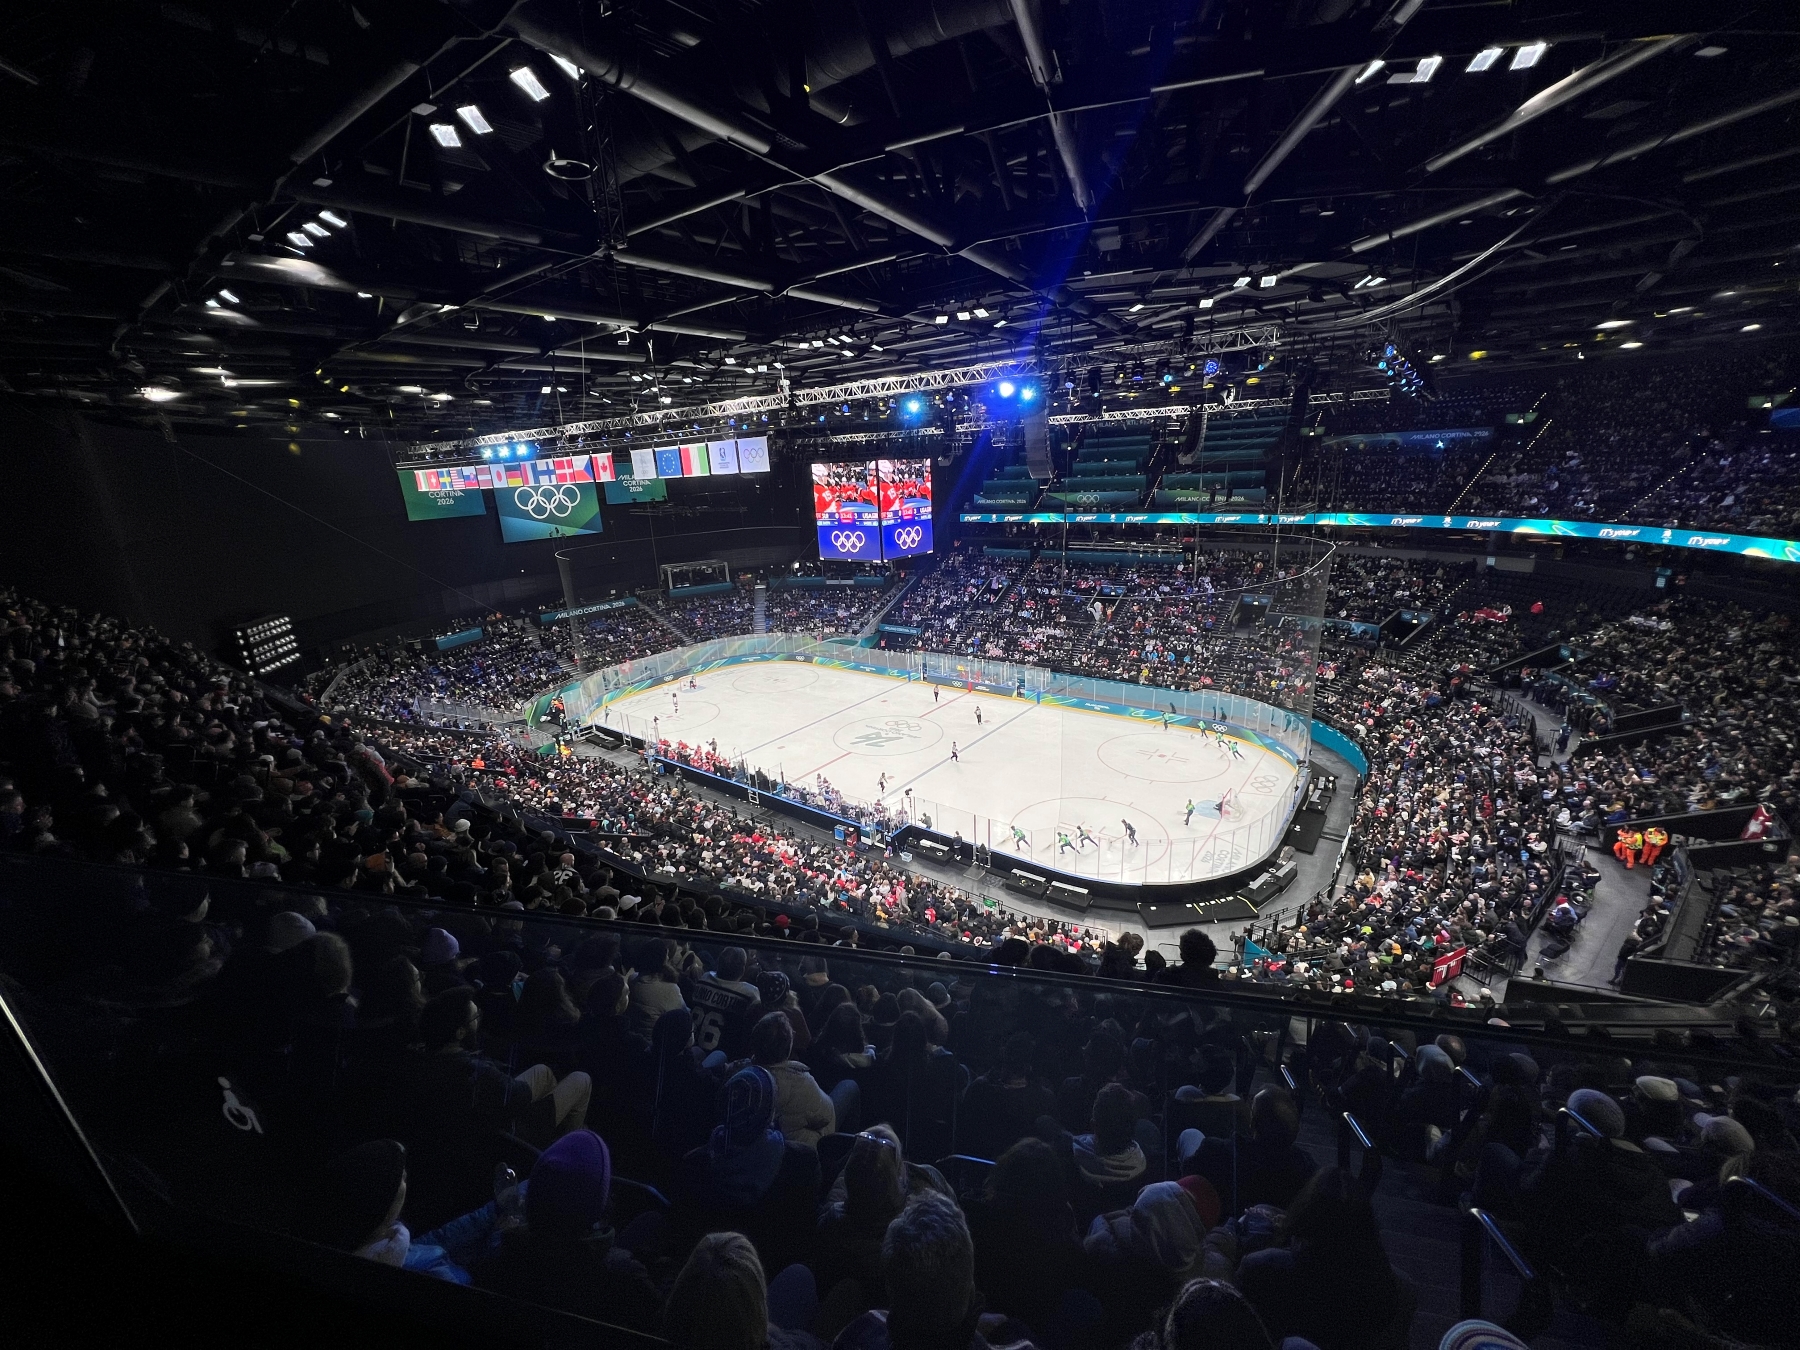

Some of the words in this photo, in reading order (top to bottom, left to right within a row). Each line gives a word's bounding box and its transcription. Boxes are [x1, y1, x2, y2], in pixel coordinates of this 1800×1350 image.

[1441, 431, 1472, 439] CORTINA
[623, 479, 652, 487] CORTINA
[428, 490, 465, 498] CORTINA
[437, 497, 455, 506] 2026
[554, 609, 583, 620] MILANO
[583, 604, 612, 614] CORTINA
